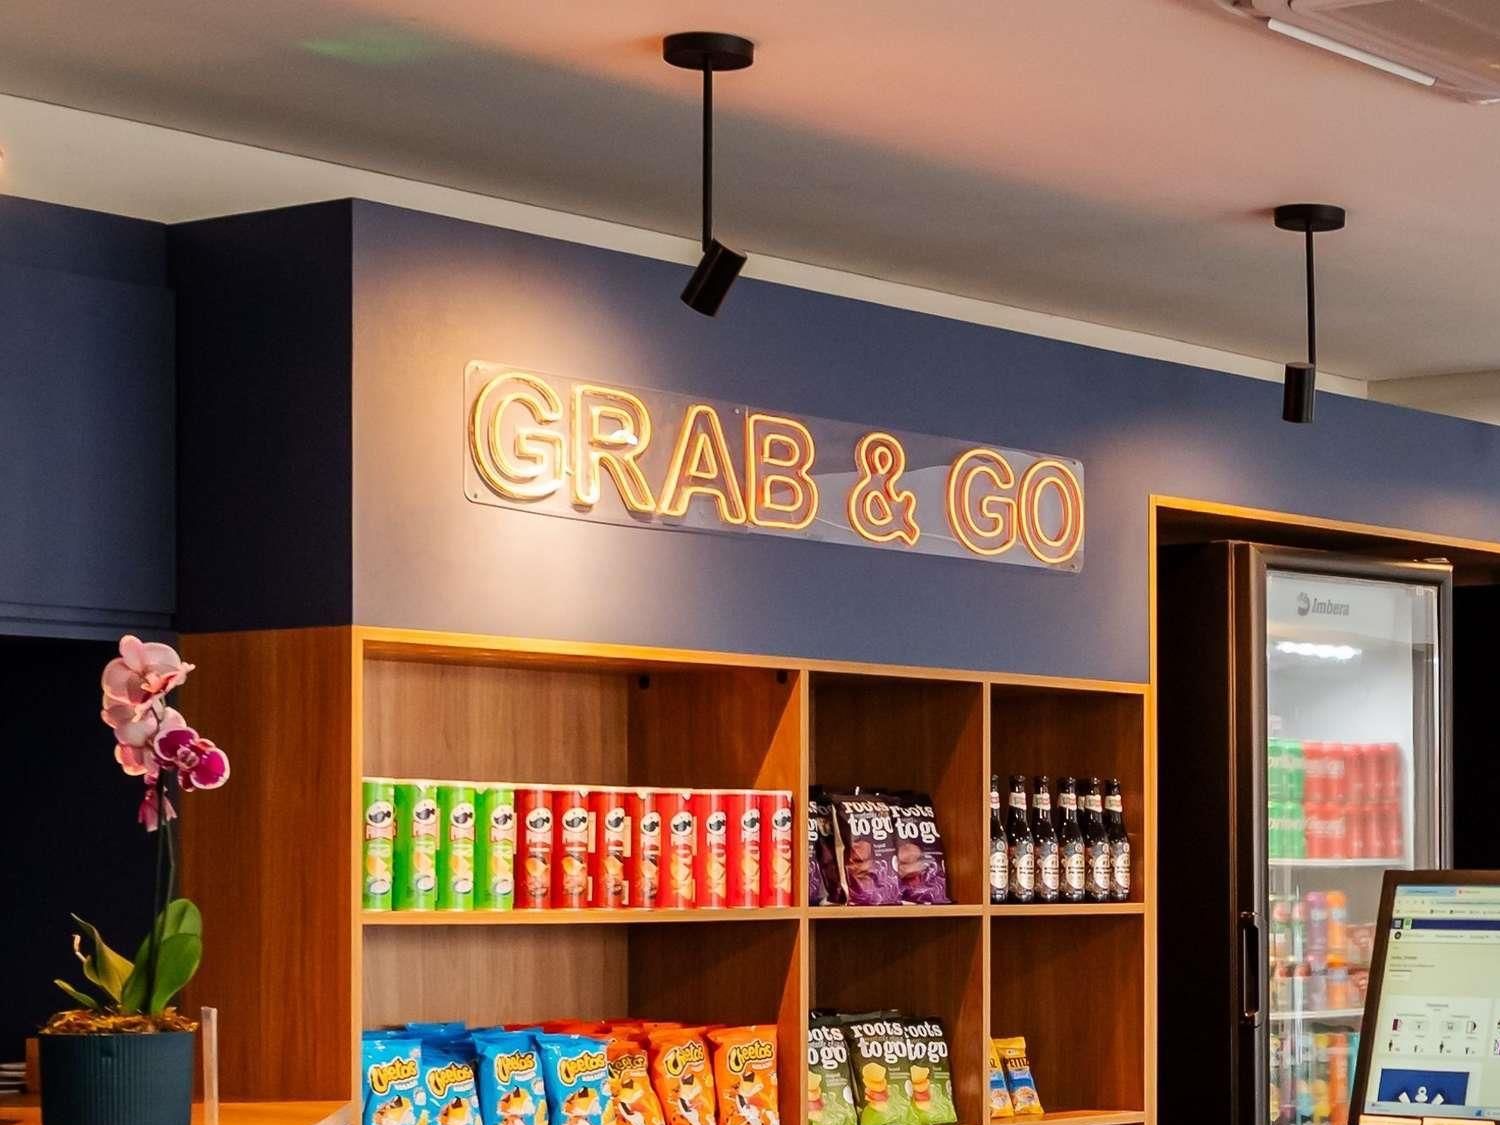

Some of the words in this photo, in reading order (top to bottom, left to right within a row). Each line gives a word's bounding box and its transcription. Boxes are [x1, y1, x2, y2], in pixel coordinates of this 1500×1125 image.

[469, 371, 819, 530] GRAB
[847, 431, 921, 546] &
[945, 447, 1083, 564] GO
[848, 813, 870, 836] to
[895, 818, 919, 839] to
[851, 1020, 903, 1038] roots
[728, 1041, 775, 1072] Cheetos
[820, 1045, 848, 1070] go
[858, 1037, 883, 1058] to
[883, 1040, 907, 1064] go
[927, 1041, 948, 1063] go
[369, 1056, 420, 1096] Cheetos
[426, 1062, 474, 1098] Cheetos
[494, 1050, 538, 1084] Cheetos
[557, 1051, 607, 1086] Cheetos
